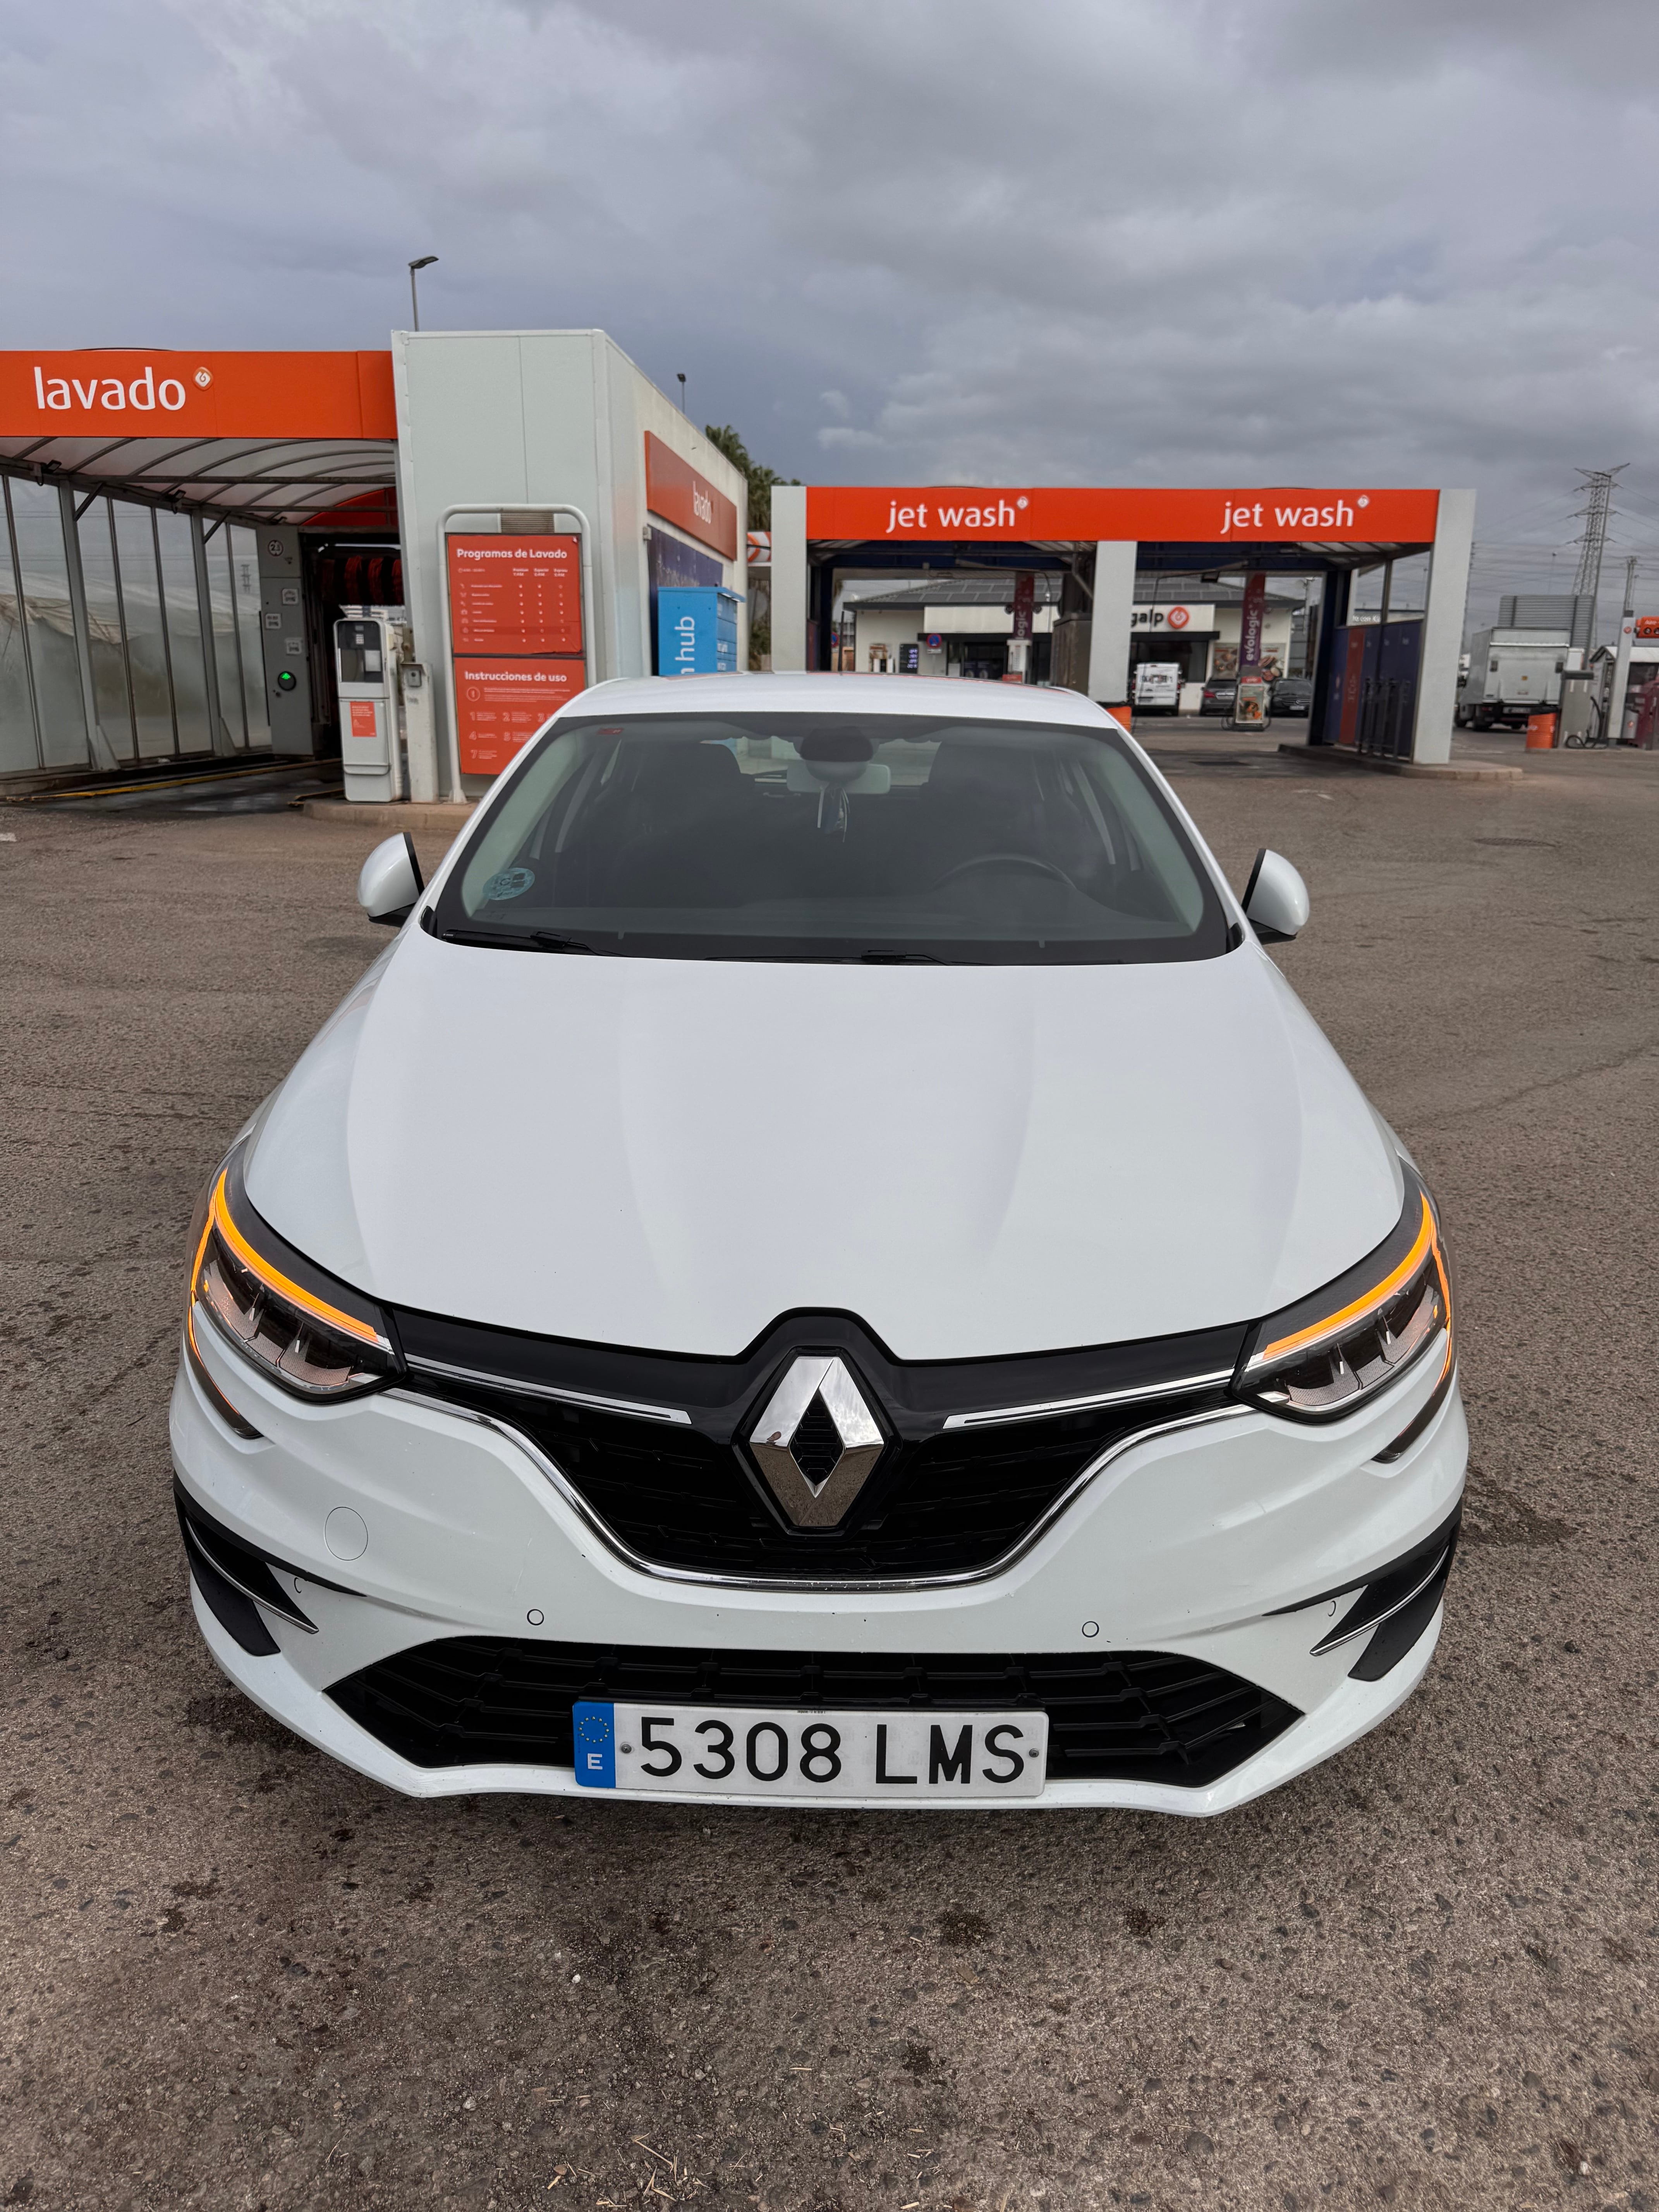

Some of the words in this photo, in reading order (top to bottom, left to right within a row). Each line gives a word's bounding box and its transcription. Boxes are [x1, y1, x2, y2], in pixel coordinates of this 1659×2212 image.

[34, 366, 185, 410] lavado
[693, 480, 711, 524] lavado
[886, 500, 928, 533] jet
[938, 500, 1015, 527] wash
[1220, 501, 1264, 534] jet
[1274, 500, 1354, 527] wash
[457, 548, 513, 560] Programas
[515, 548, 527, 558] de
[529, 549, 567, 558] Lavado
[674, 617, 695, 661] hub
[1015, 611, 1029, 639] logic
[1244, 608, 1259, 661] evologic
[465, 671, 532, 681] Instrucciones
[534, 672, 546, 681] de
[587, 1753, 603, 1770] E
[640, 1716, 842, 1783] 5308
[876, 1724, 1024, 1784] LMS
